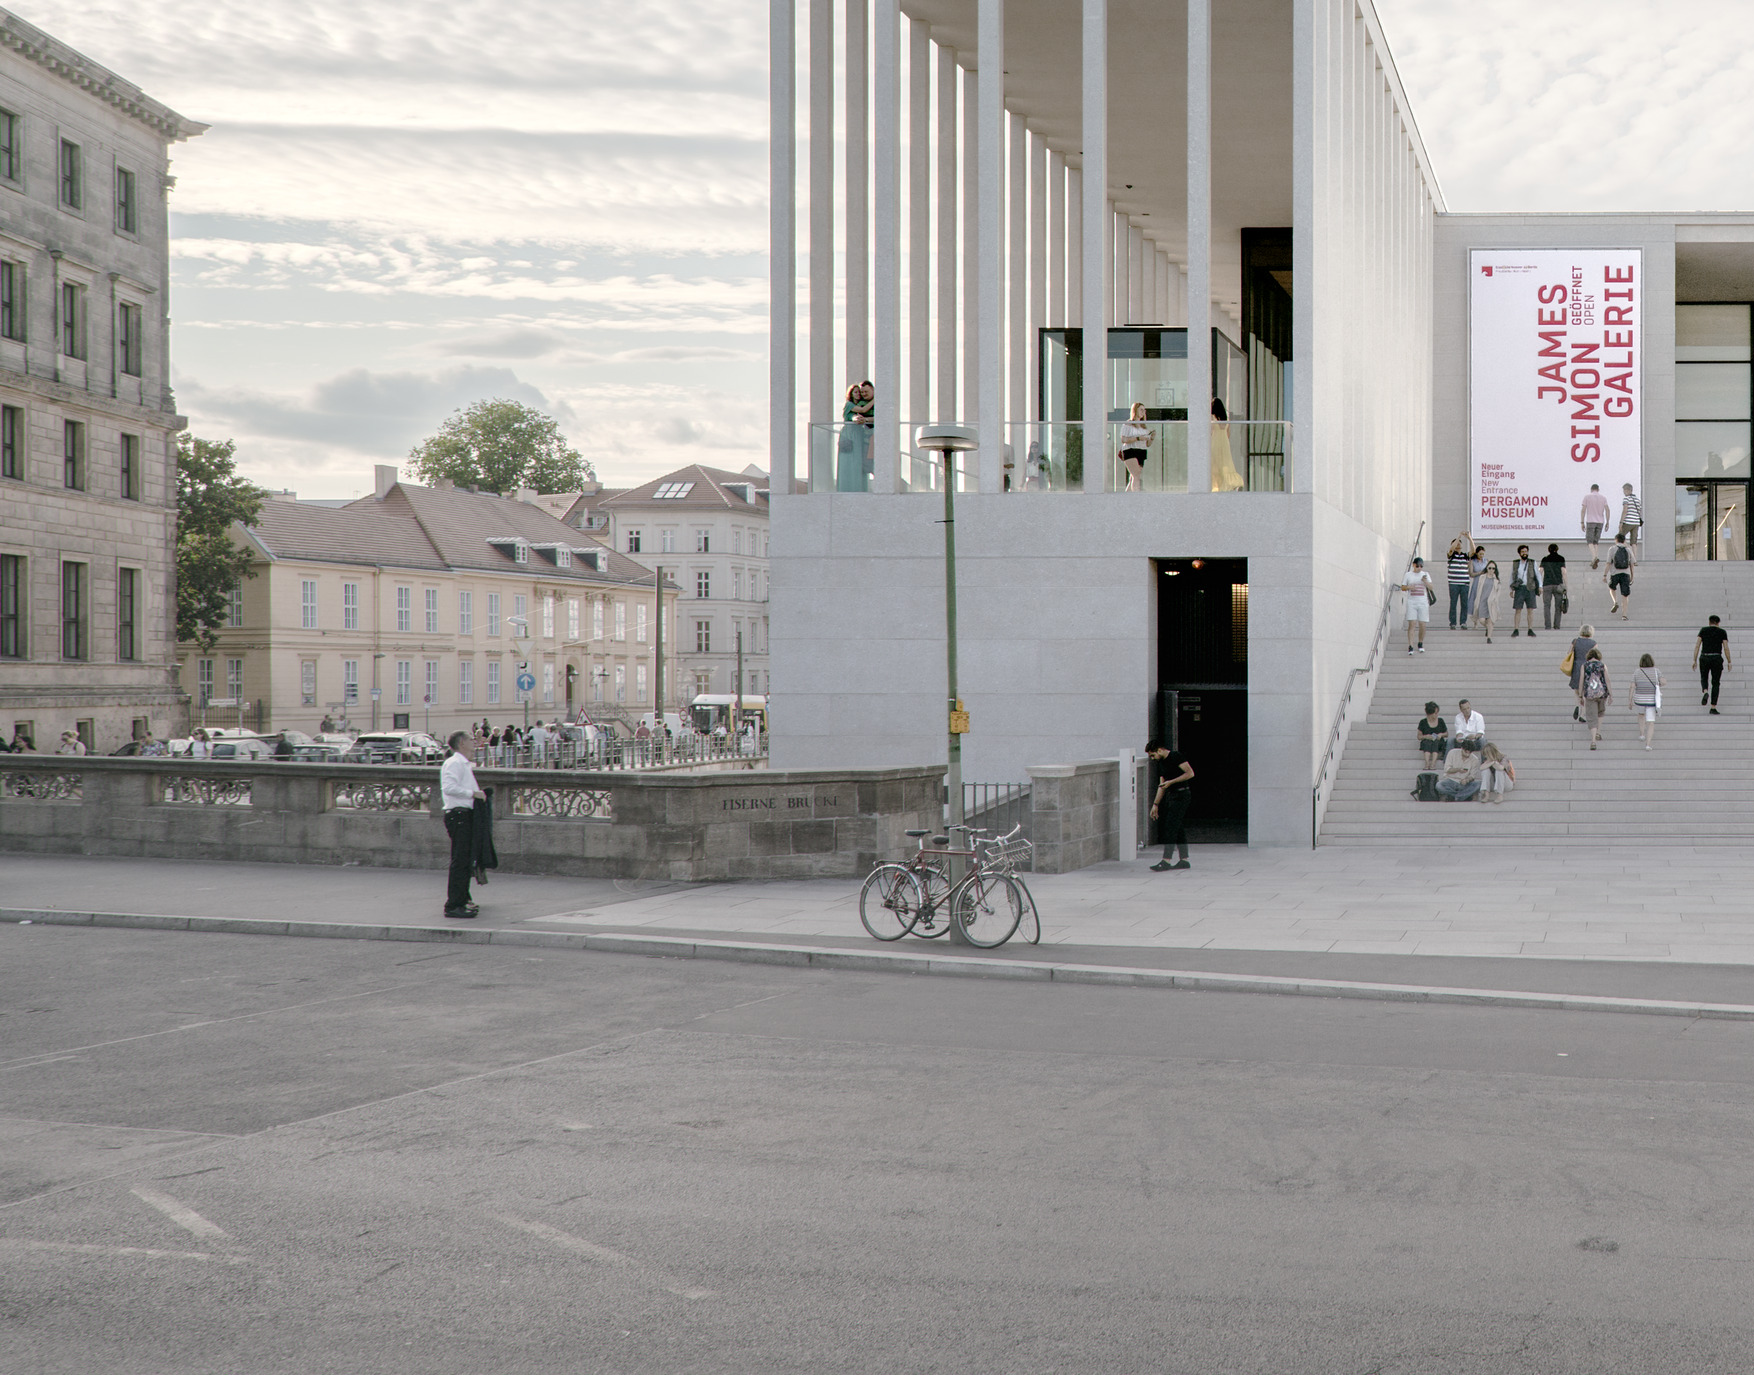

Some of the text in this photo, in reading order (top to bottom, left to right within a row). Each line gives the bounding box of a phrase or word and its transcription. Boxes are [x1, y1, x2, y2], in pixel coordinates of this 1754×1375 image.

[1569, 265, 1583, 326] GEÖFFNET
[1584, 295, 1595, 326] OPEN
[1537, 284, 1567, 404] JAMES
[1603, 265, 1634, 418] GALERIE
[1570, 343, 1601, 463] SIMON
[1481, 463, 1504, 471] Neuer
[1481, 470, 1516, 480] Eingang
[1481, 479, 1500, 487] New
[1481, 486, 1519, 494] Entrance
[1481, 495, 1549, 507] PERGAMON
[1481, 507, 1535, 519] MUSEUM
